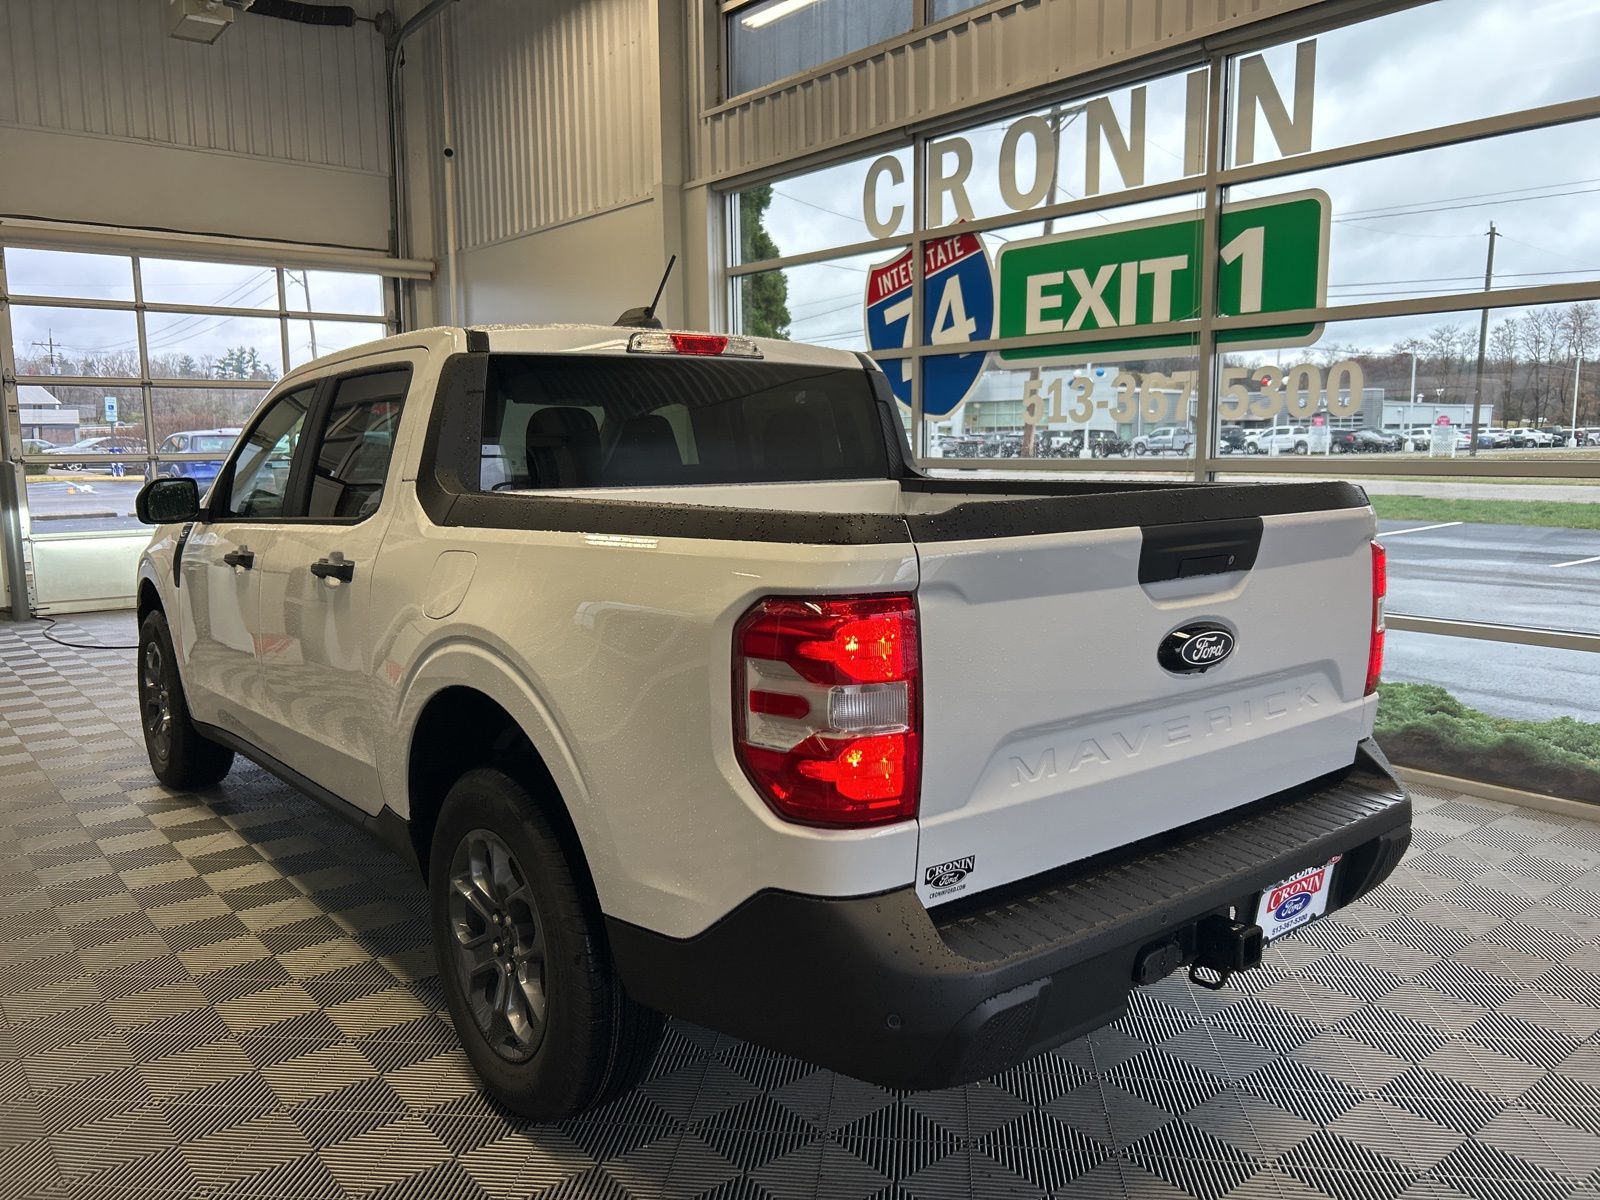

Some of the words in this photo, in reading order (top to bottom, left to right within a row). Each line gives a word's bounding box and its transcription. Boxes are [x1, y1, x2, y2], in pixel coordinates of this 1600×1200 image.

[863, 38, 1318, 239] CRONIN
[877, 236, 965, 297] INTERTATE
[1026, 254, 1188, 335] EXIT
[1220, 226, 1265, 314] 1
[884, 274, 977, 382] 74
[1192, 636, 1224, 661] Ford
[1009, 684, 1319, 787] MAVERICK
[926, 856, 974, 881] CRONIN
[938, 872, 960, 886] Ford
[1270, 873, 1323, 910] CRONIN
[1281, 896, 1306, 917] Ford
